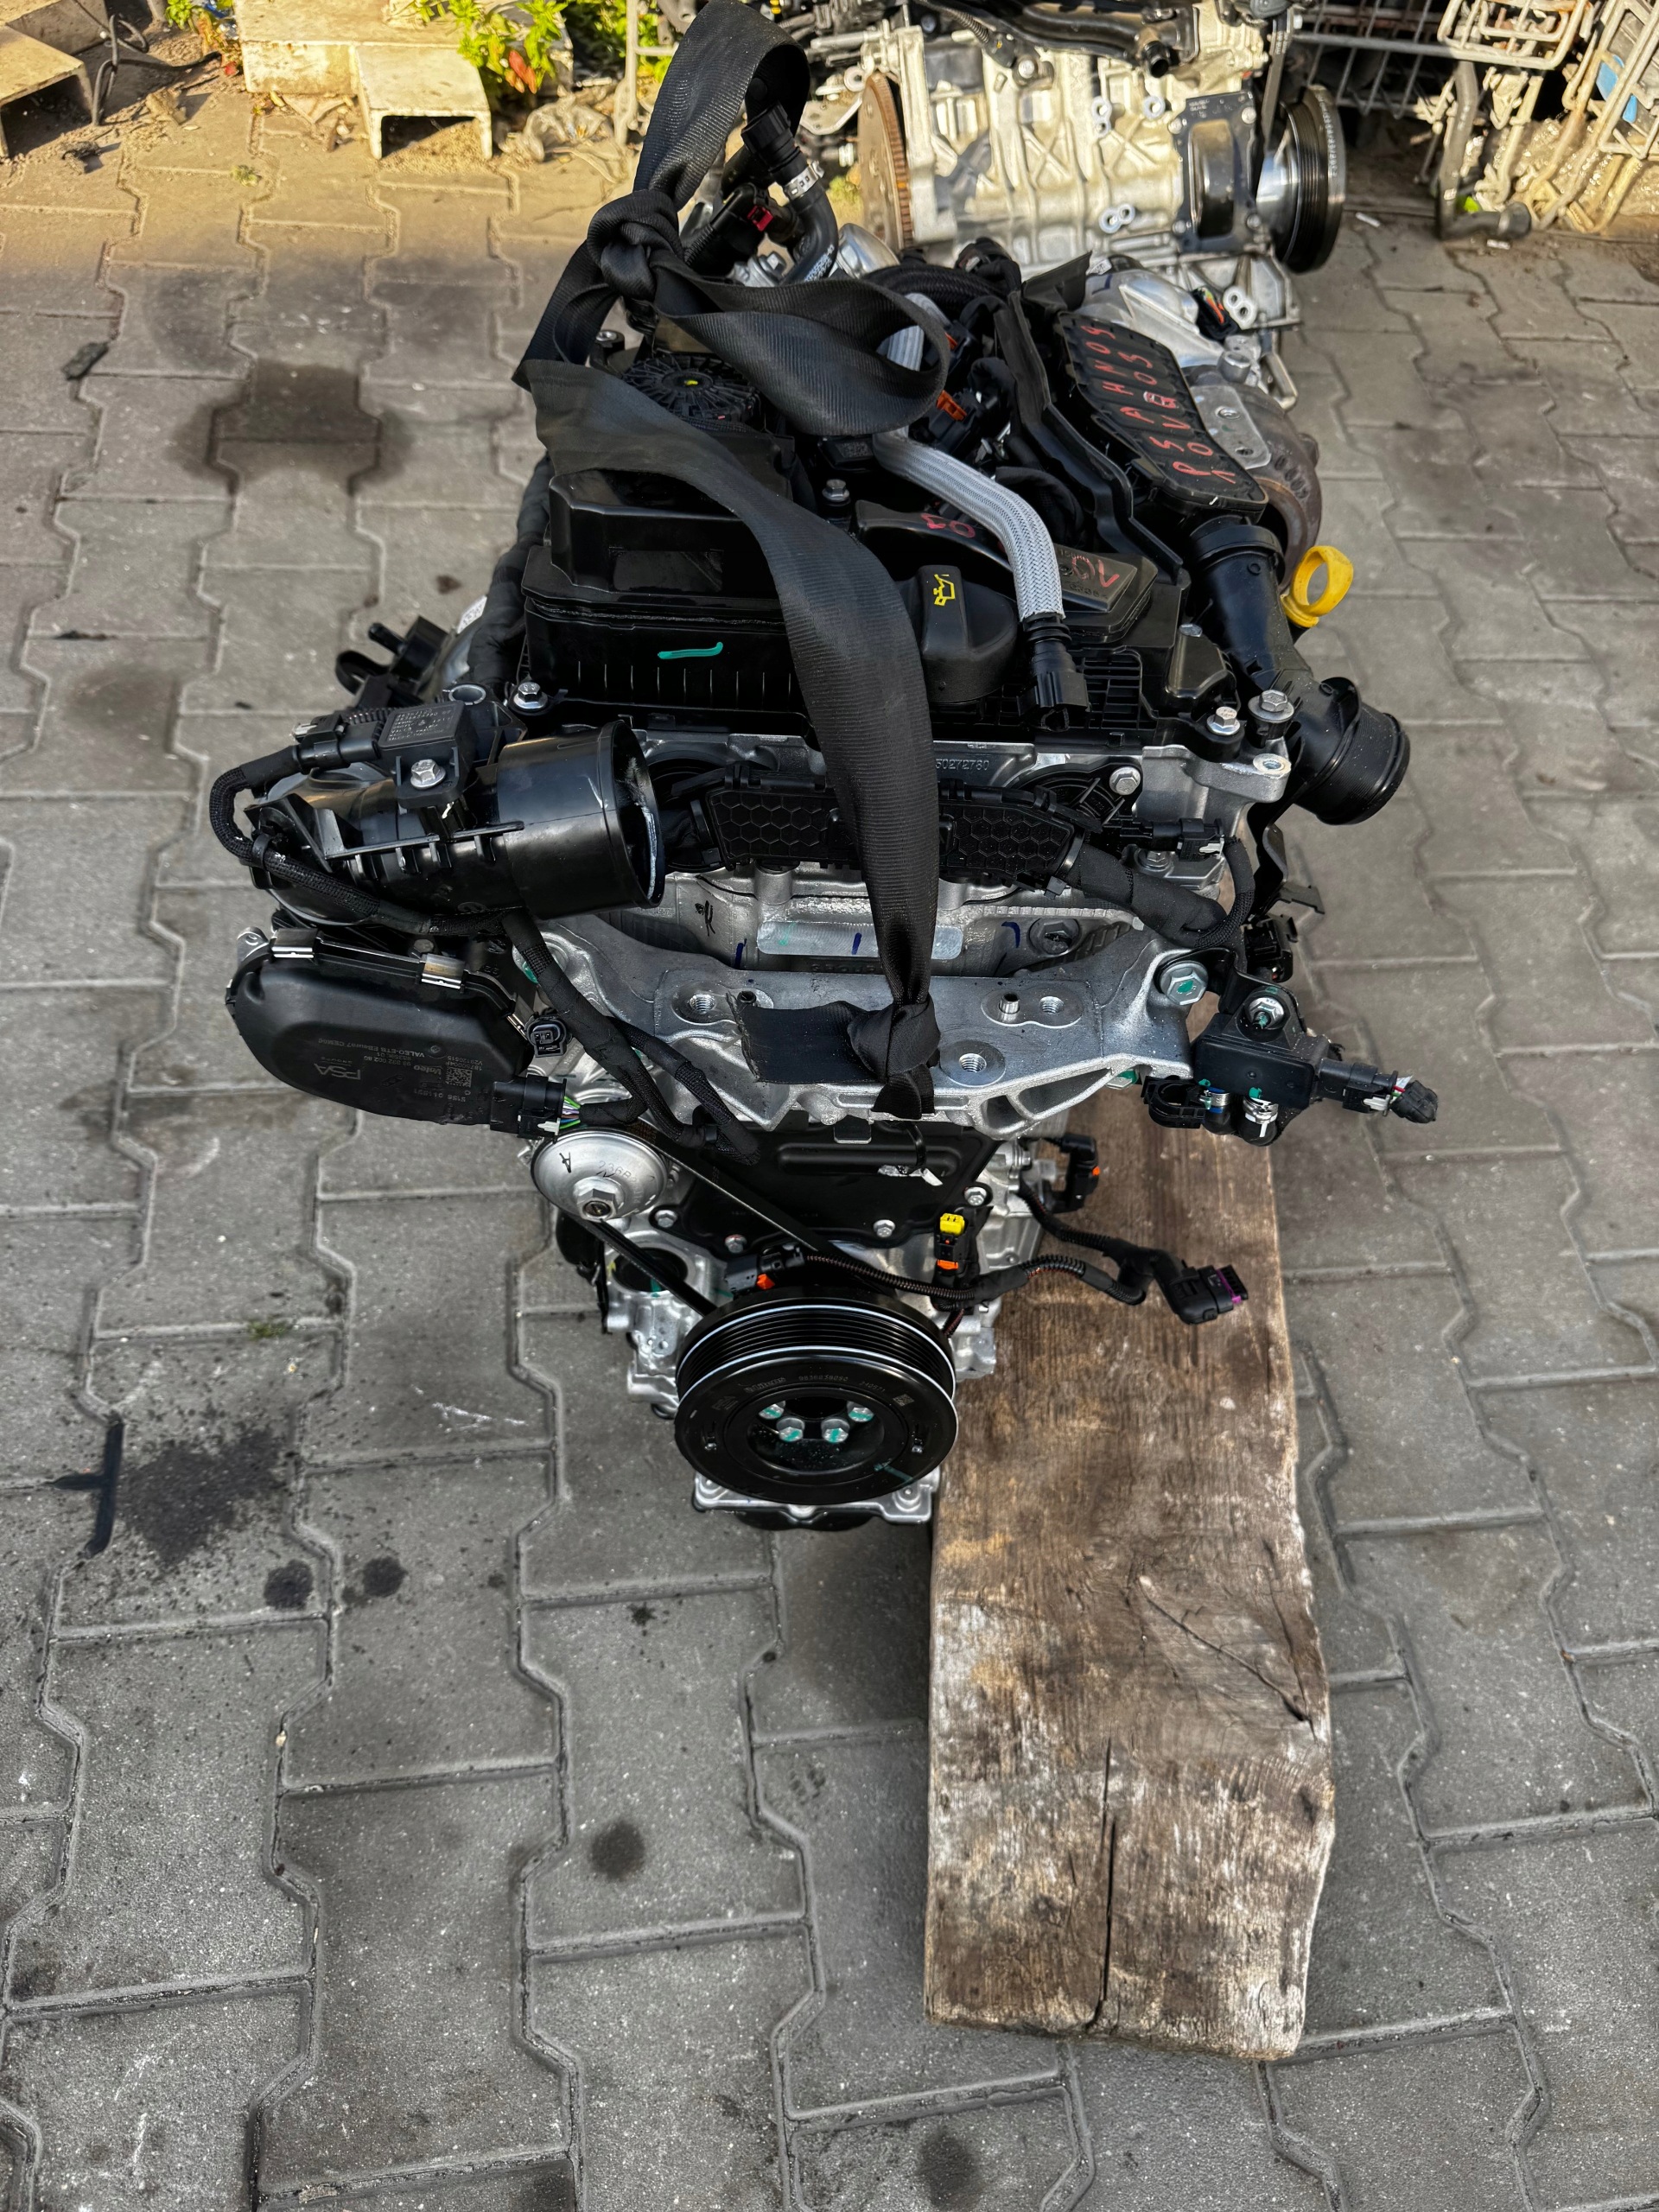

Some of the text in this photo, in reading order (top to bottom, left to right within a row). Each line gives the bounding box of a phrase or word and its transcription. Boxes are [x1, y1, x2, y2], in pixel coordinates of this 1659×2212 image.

[1120, 406, 1211, 475] PSA
[314, 1064, 361, 1080] PSA
[413, 1065, 442, 1075] Valeo
